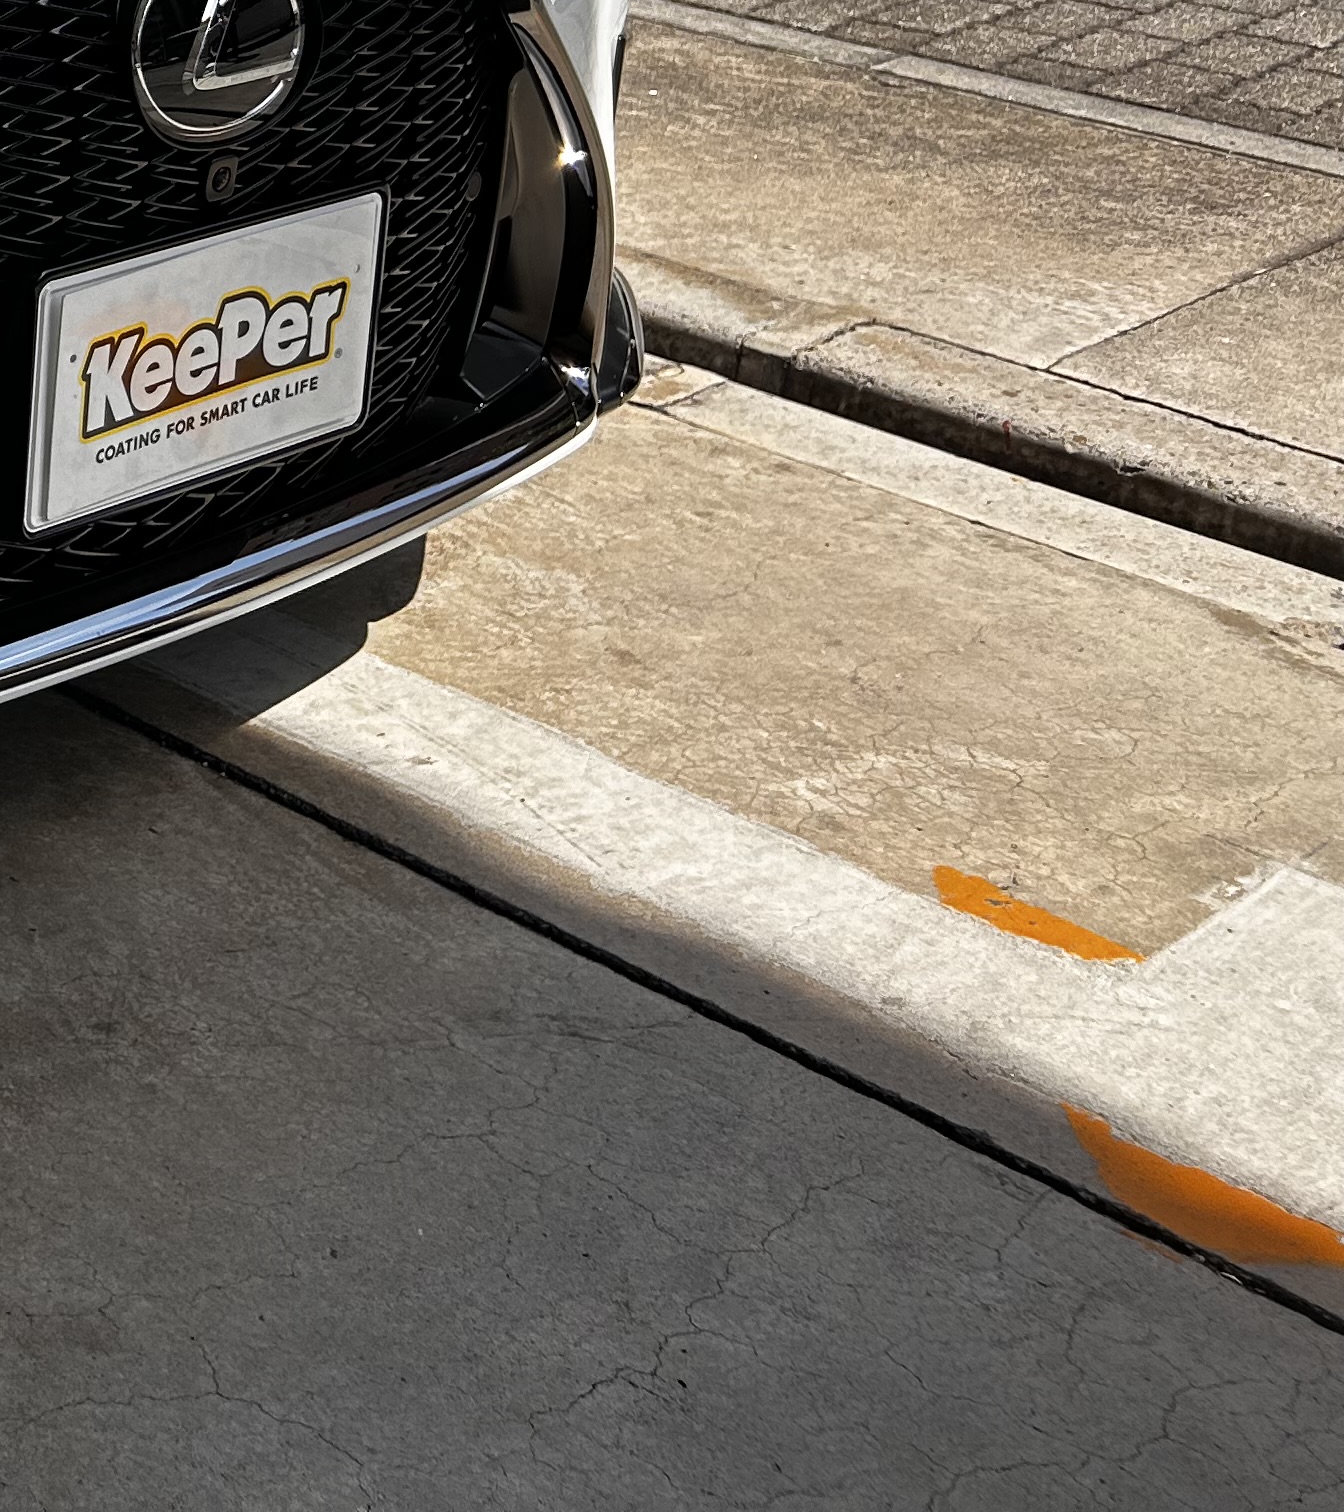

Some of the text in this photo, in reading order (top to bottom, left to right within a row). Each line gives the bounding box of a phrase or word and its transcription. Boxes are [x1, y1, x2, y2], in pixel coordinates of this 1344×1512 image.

[80, 280, 348, 440] KeePer
[95, 375, 319, 464] COATING FOR SMART CAR LIFE
